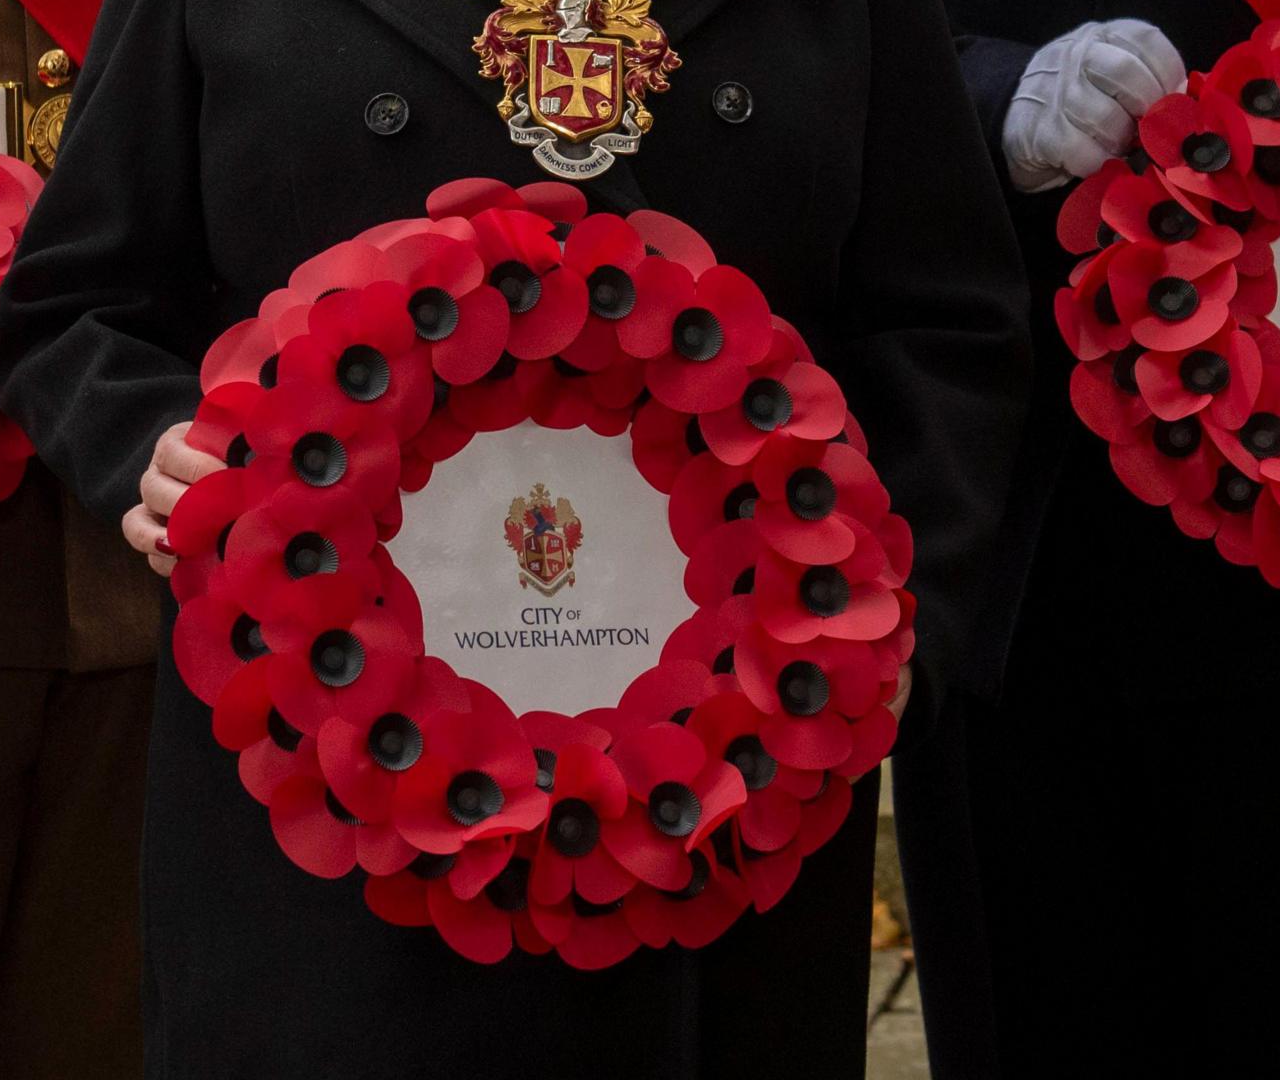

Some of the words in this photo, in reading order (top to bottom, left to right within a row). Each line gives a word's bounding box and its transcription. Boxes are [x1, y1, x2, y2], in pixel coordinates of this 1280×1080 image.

[514, 131, 532, 141] OUT
[538, 145, 577, 173] DARKNESS
[579, 151, 610, 173] COMETH
[520, 607, 564, 626] CITY
[566, 609, 582, 621] OF
[454, 628, 651, 649] WOLVERHAMPTON
